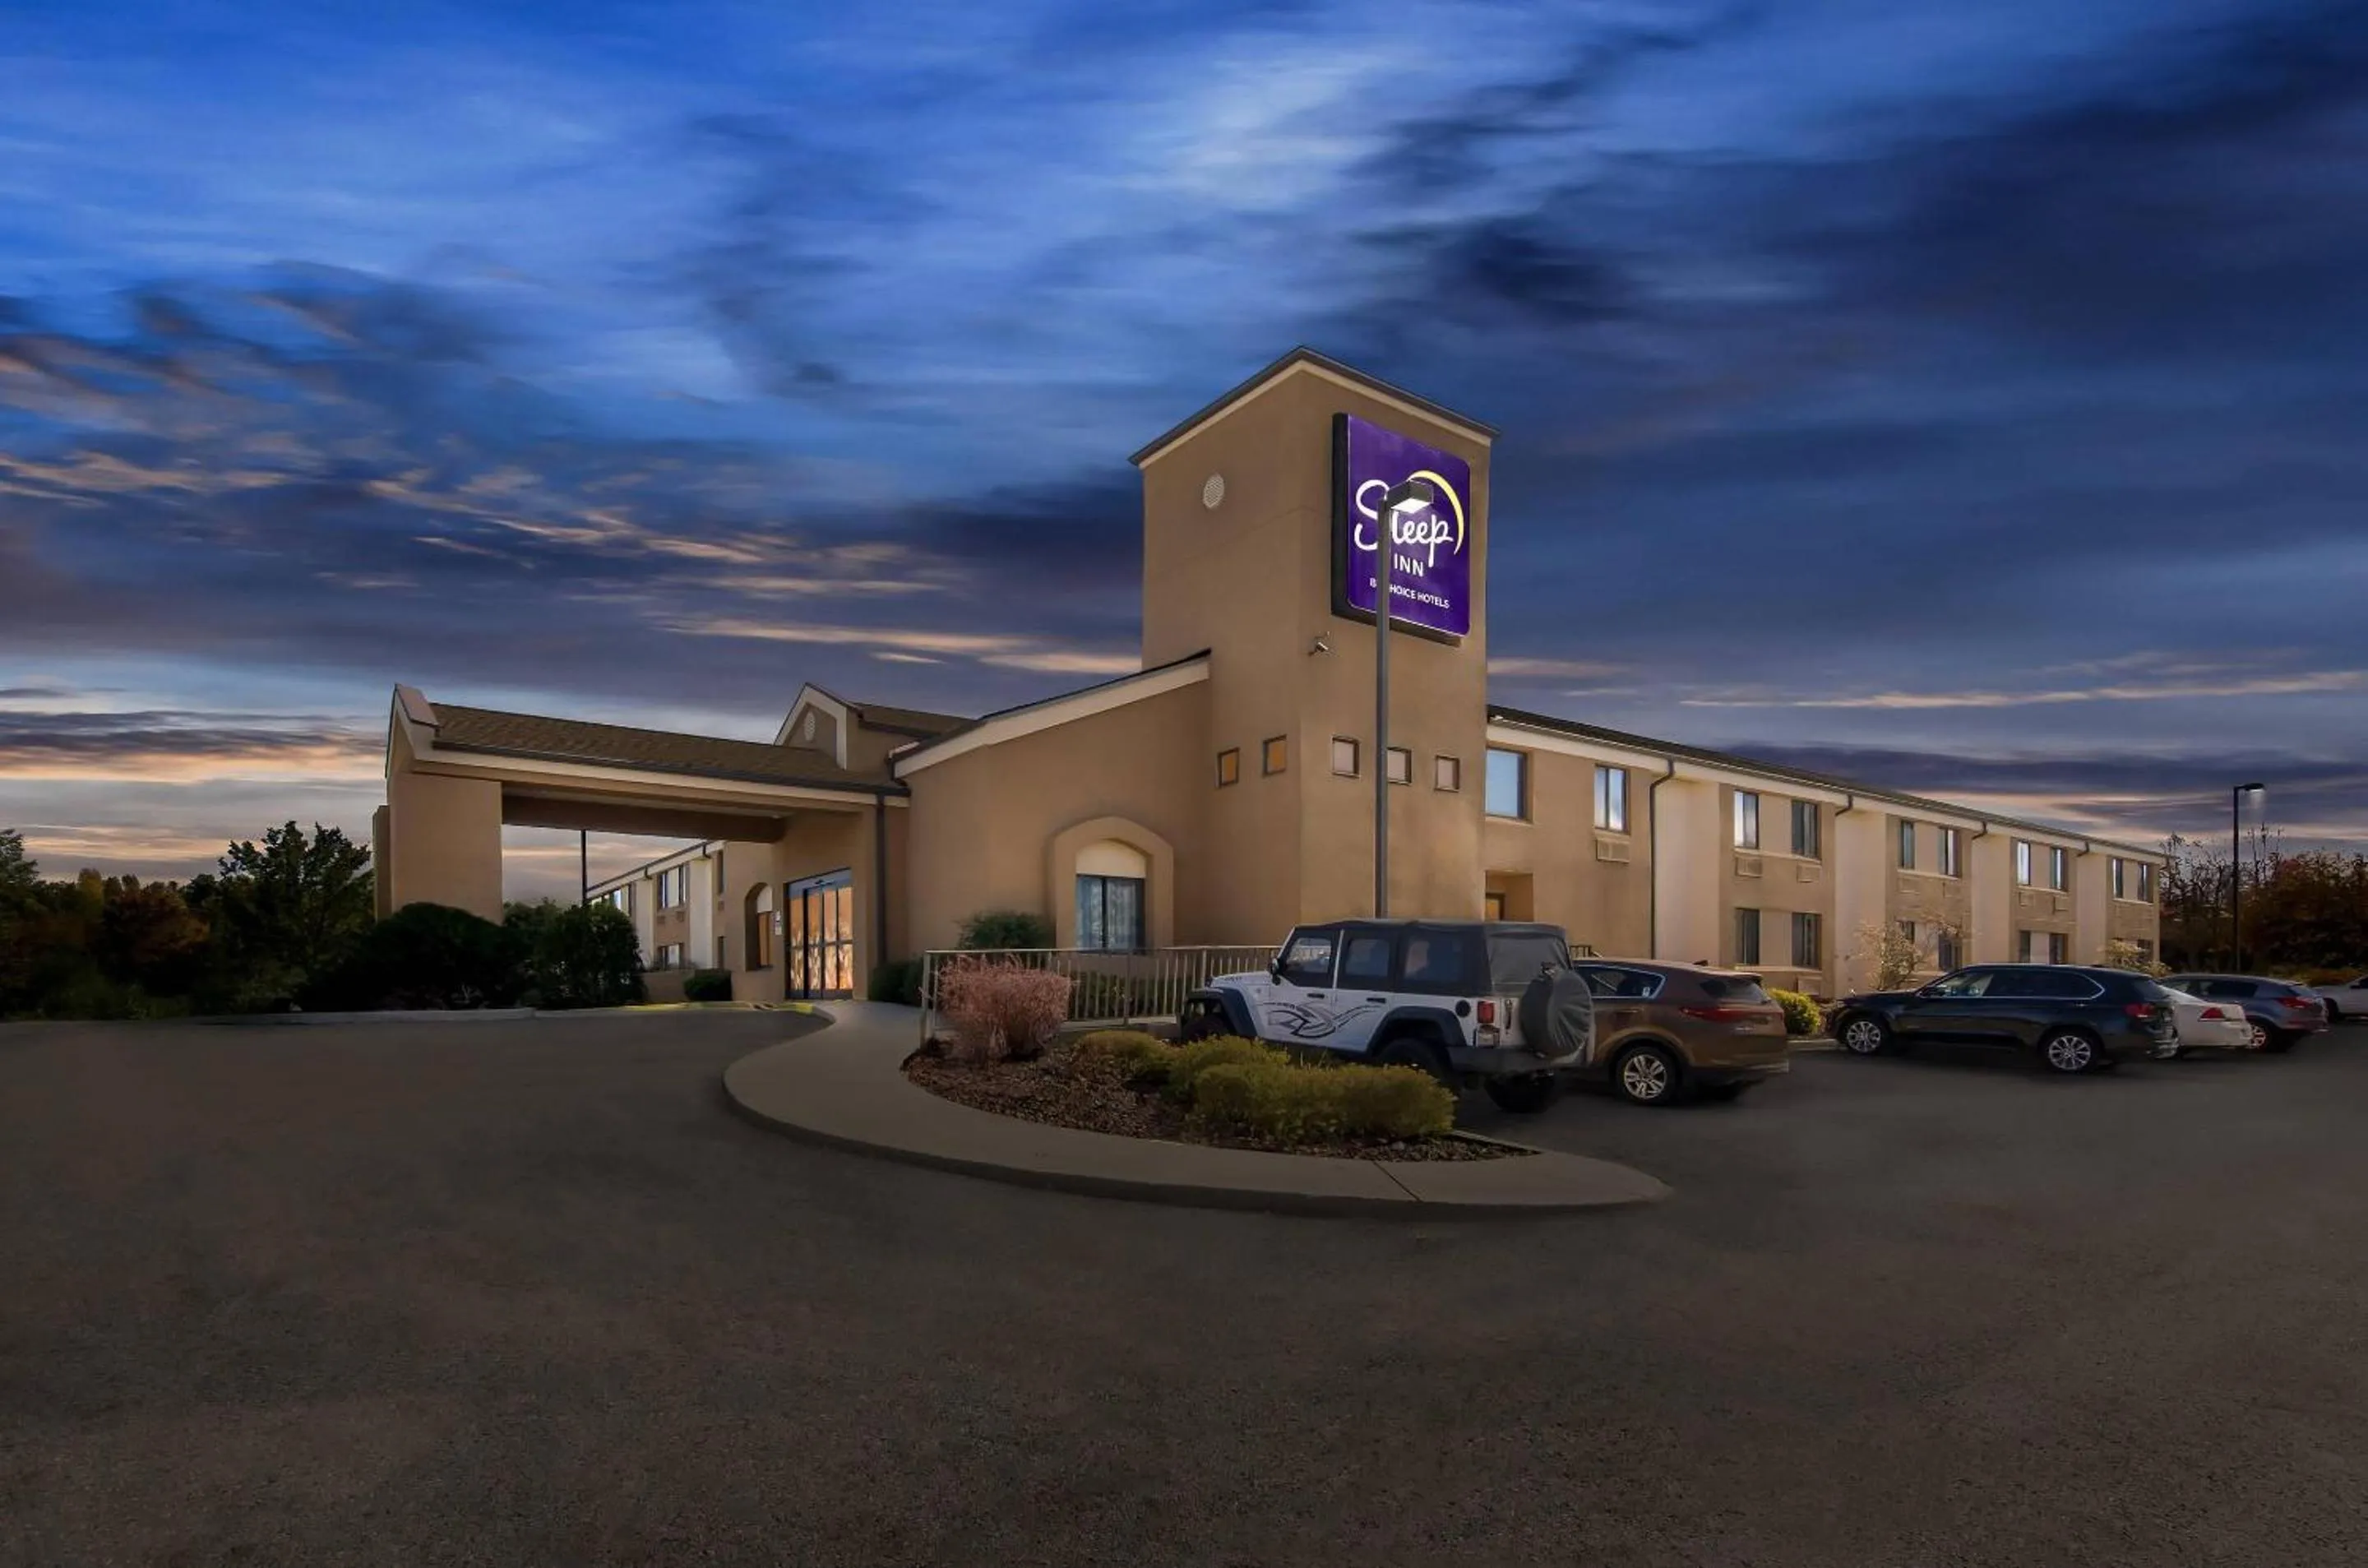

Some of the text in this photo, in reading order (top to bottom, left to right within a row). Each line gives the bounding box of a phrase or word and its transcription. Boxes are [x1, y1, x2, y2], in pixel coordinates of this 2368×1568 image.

[1354, 479, 1453, 567] Sleep
[1394, 553, 1424, 576] INN
[1389, 584, 1417, 599] HOICE
[1417, 592, 1450, 608] HOTELS
